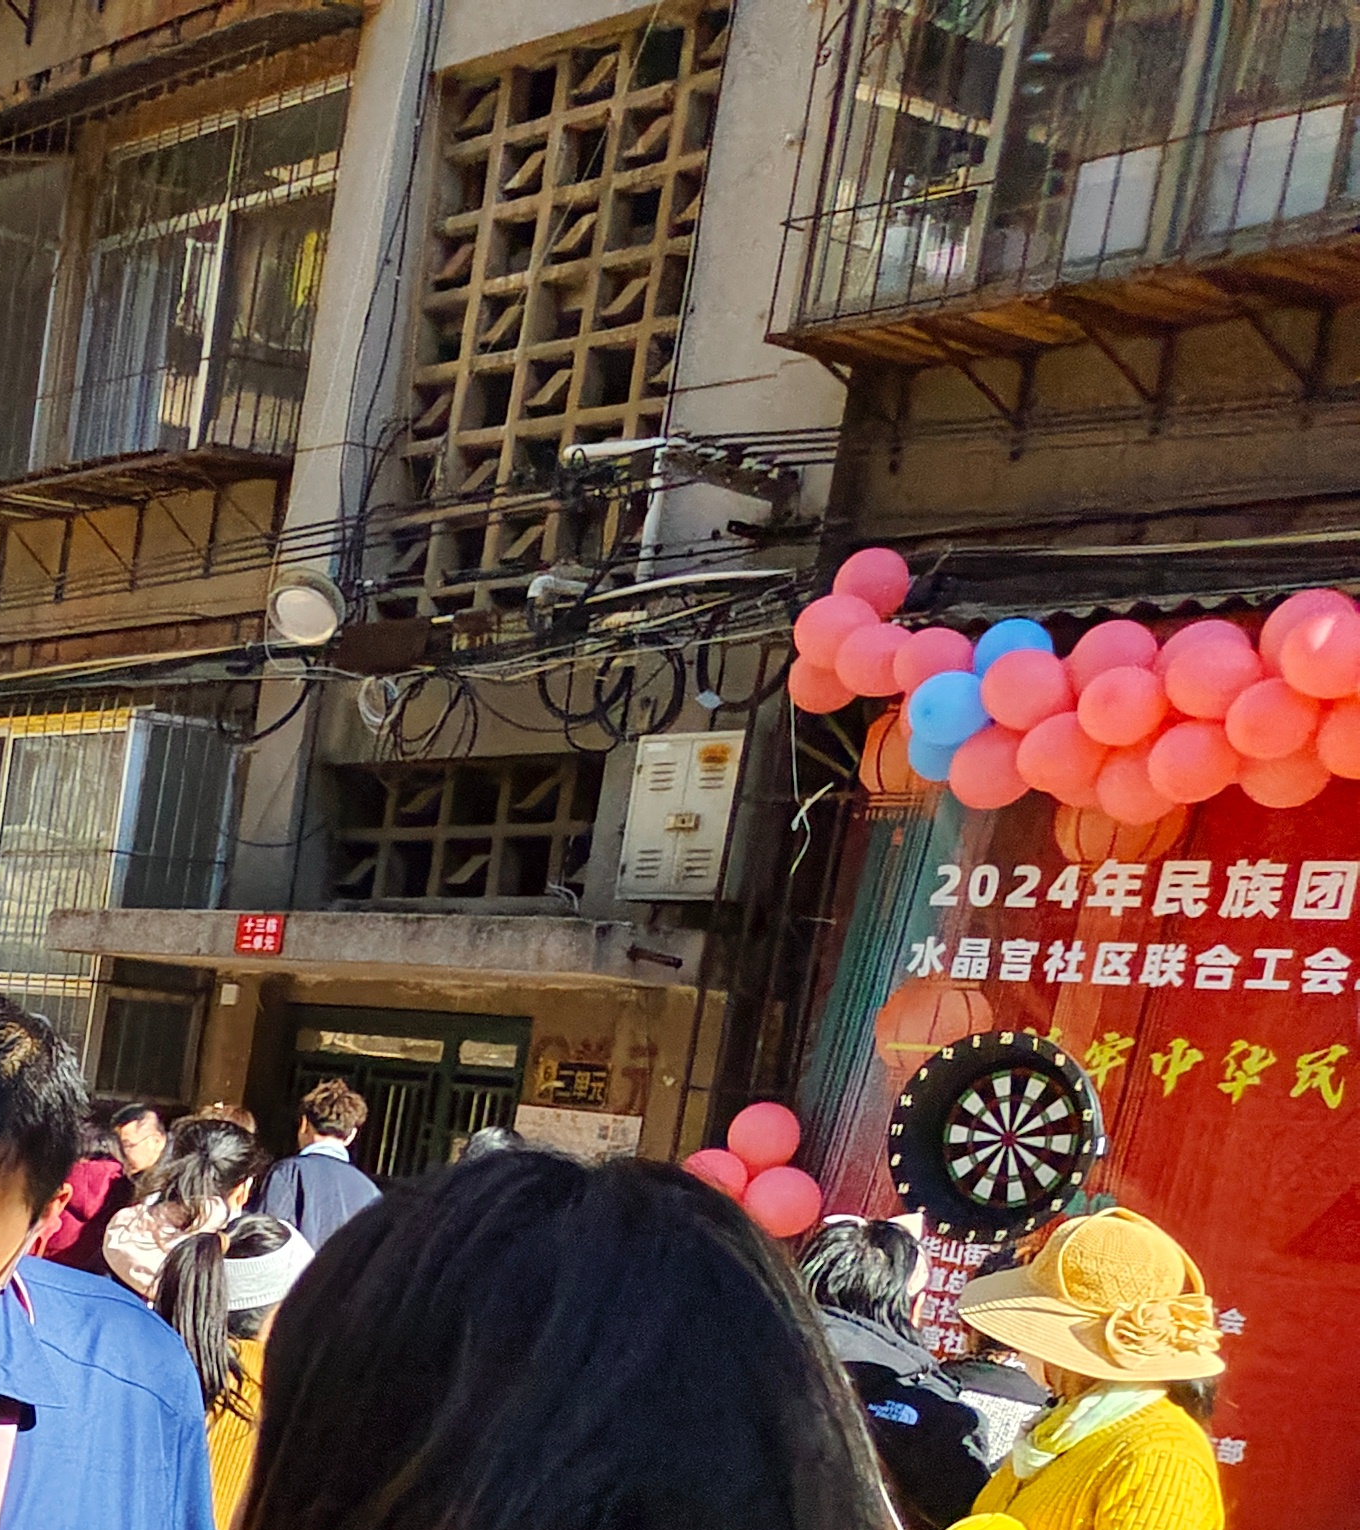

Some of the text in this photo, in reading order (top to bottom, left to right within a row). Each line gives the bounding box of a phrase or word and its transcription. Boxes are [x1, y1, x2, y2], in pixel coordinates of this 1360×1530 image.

[929, 859, 1359, 920] 2024年民族团
[906, 937, 1360, 994] 水晶宫社区联合工会
[999, 1031, 1014, 1045] 20
[1031, 1037, 1039, 1051] 1
[941, 1047, 954, 1060] 12
[918, 1067, 929, 1081] 9
[1023, 1027, 1349, 1110] 牢中华民
[890, 1123, 904, 1136] 11
[1024, 1217, 1035, 1231] 2
[965, 1229, 976, 1243] 3
[1213, 1307, 1247, 1336] 会
[1211, 1436, 1247, 1465] 部
